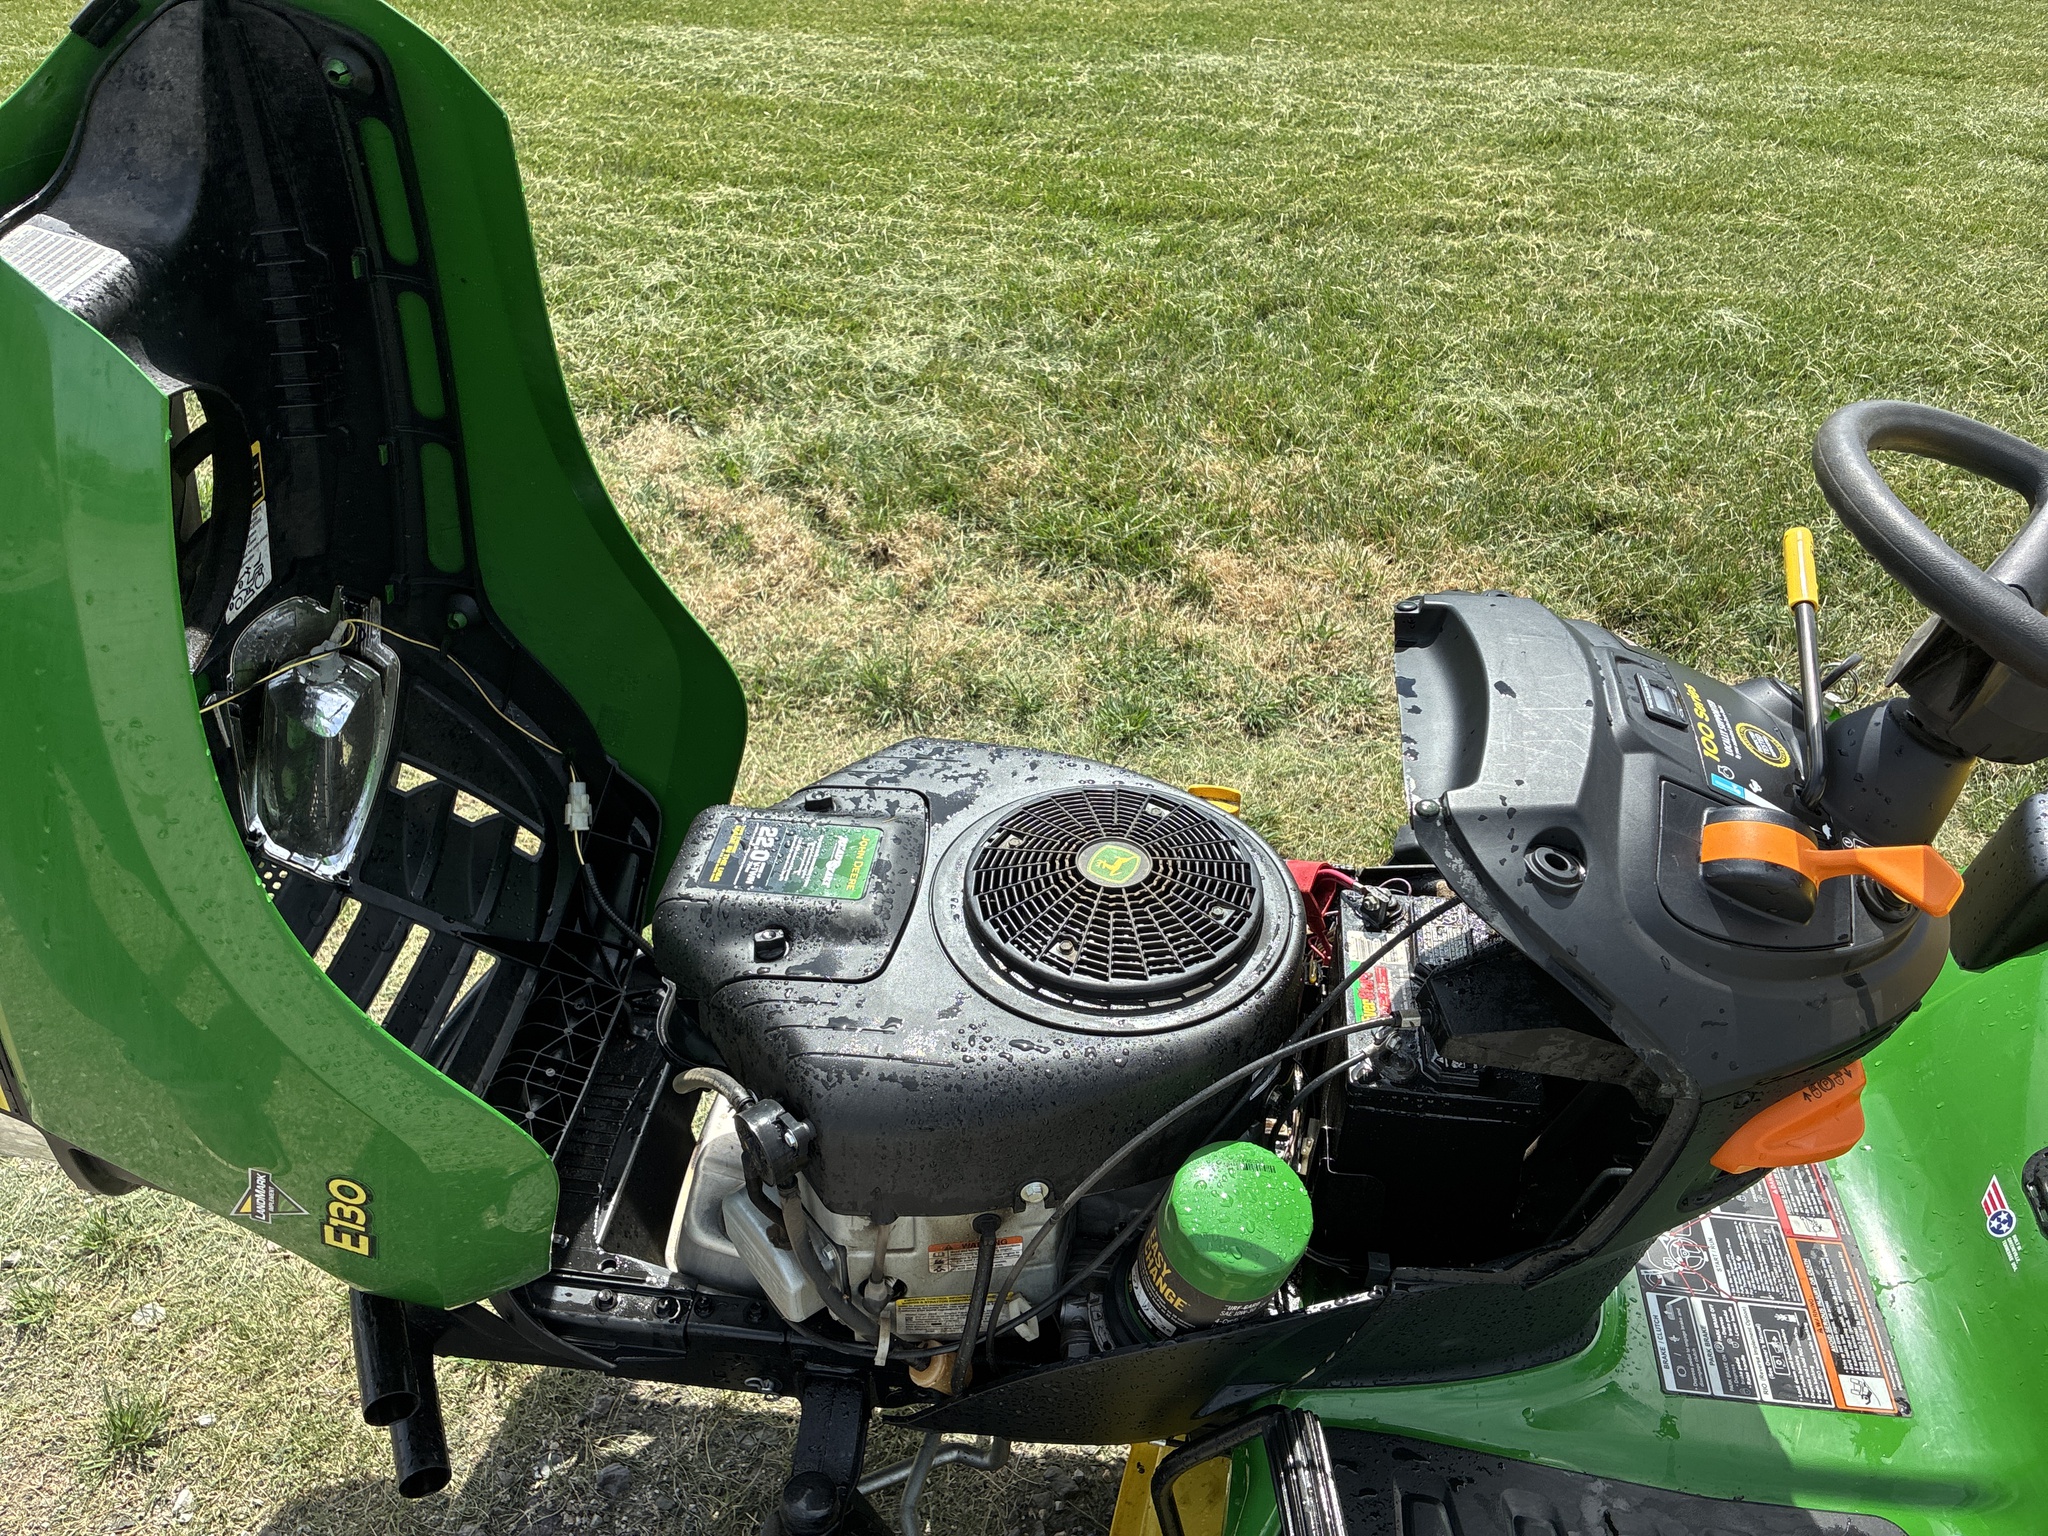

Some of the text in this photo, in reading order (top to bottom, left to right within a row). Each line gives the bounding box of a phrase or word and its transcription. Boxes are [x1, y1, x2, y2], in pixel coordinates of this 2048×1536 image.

[1684, 683, 1720, 762] 100 Series
[751, 827, 778, 861] 22.0
[847, 834, 870, 890] JOHN DEERE
[323, 1178, 369, 1256] E130
[1150, 1227, 1171, 1277] EASY
[1714, 1256, 1722, 1272] START
[1145, 1239, 1187, 1312] CHANGE
[1654, 1314, 1663, 1340] CLUTCH
[1742, 1307, 1750, 1326] Option)
[1755, 1324, 1764, 1343] Manual)
[1660, 1347, 1669, 1369] BRAKE
[1700, 1325, 1714, 1366] PARK BRAKE
[1748, 1328, 1758, 1355] Implement
